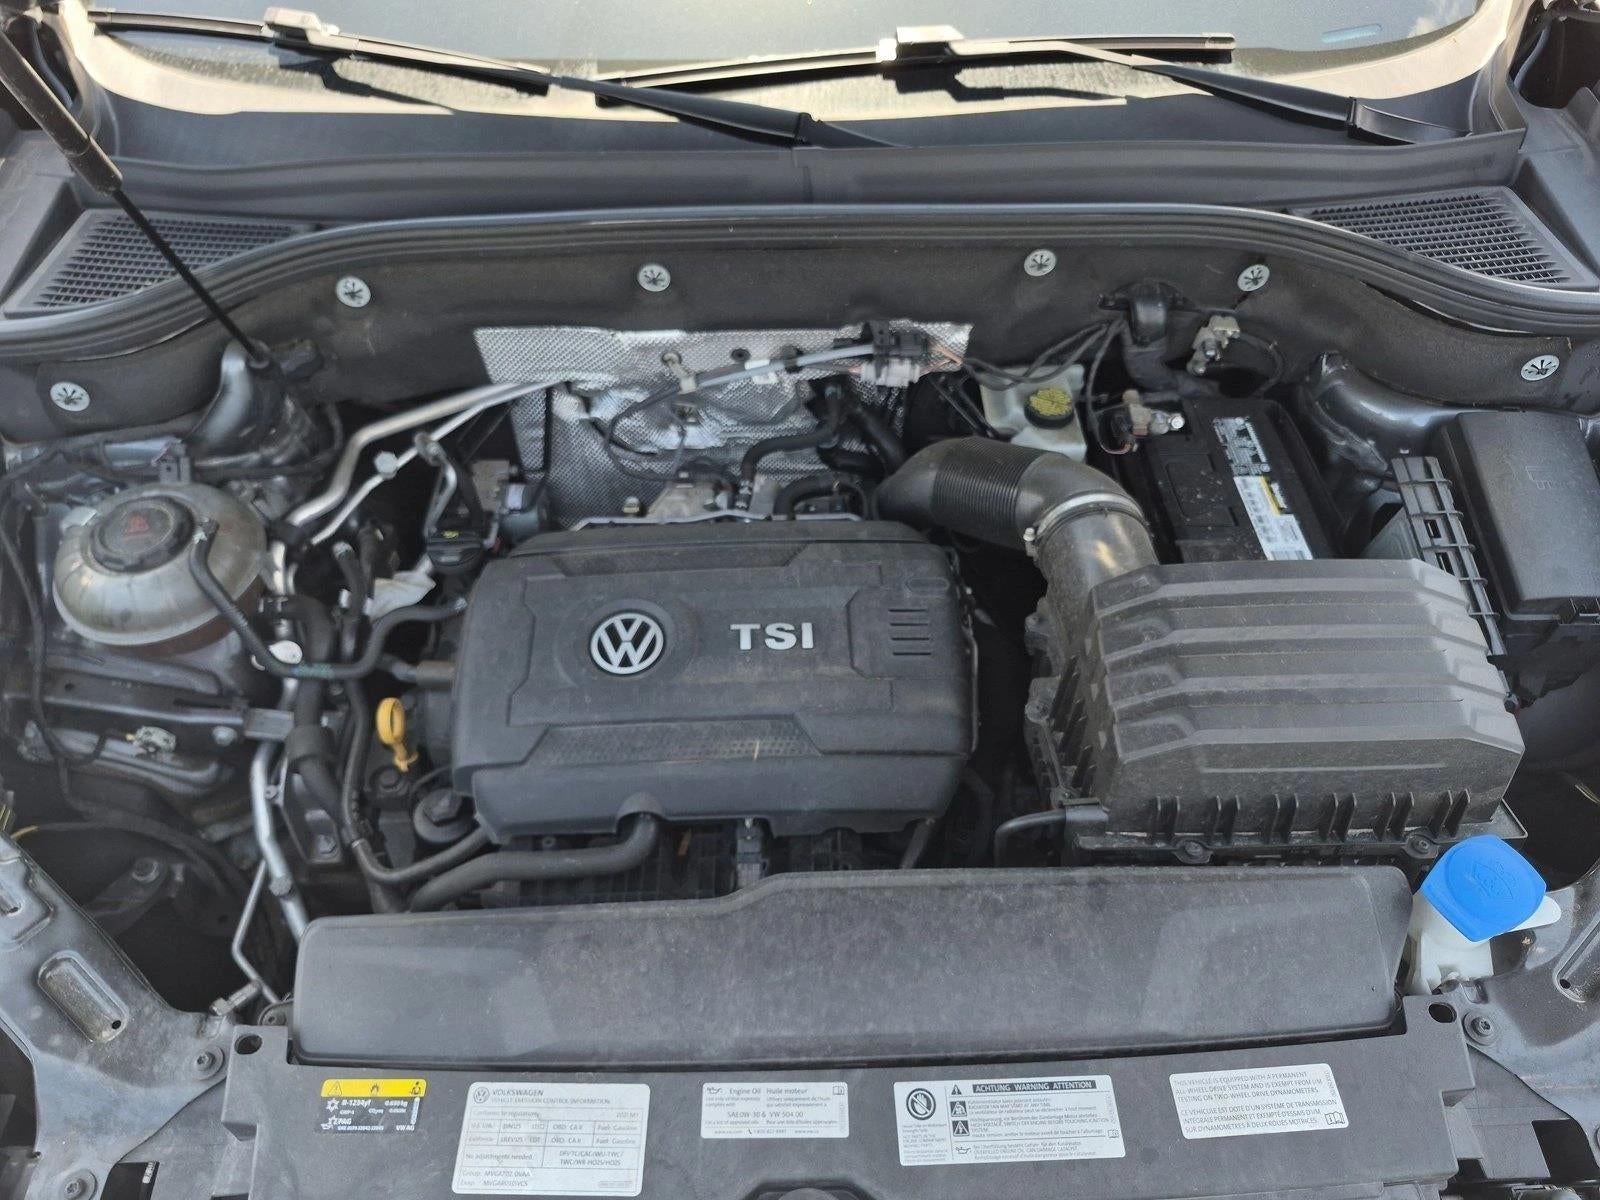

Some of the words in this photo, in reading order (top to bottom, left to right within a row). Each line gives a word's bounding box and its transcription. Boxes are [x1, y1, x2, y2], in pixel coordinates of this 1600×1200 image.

[730, 622, 814, 650] TSI
[1188, 1078, 1211, 1086] VEHICLE
[1220, 1075, 1249, 1083] EQUIPPED
[1272, 1071, 1307, 1080] PERMANENT
[975, 1084, 1011, 1093] ACHTUNG
[1013, 1082, 1050, 1092] WARNING
[1052, 1081, 1093, 1090] ATTENTION
[1209, 1085, 1227, 1093] DRIVE
[1228, 1084, 1250, 1092] SYSTEM
[1271, 1080, 1294, 1088] EXEMPT
[492, 1089, 544, 1097] VOLKSWAGEN
[730, 1088, 751, 1096] Engine
[1252, 1089, 1270, 1098] DRIVE
[1295, 1099, 1338, 1107] TRANSMISSION
[1214, 1113, 1248, 1122] PERMANENT
[1268, 1119, 1289, 1127] ROUES
